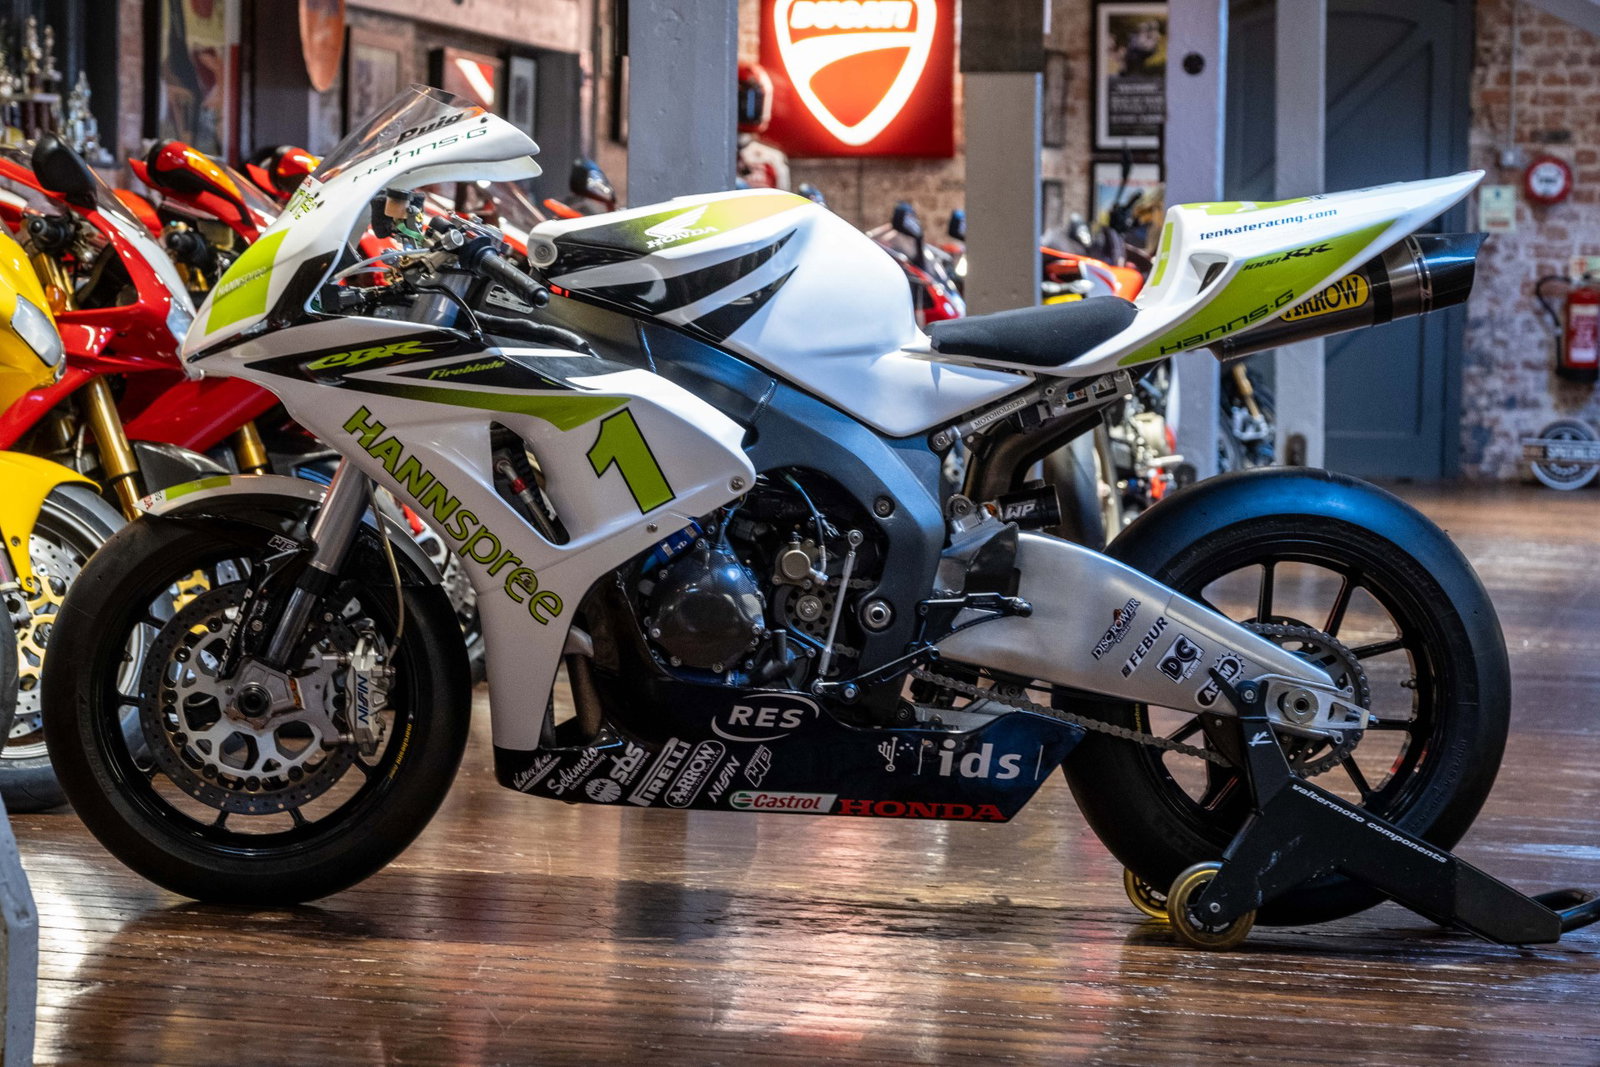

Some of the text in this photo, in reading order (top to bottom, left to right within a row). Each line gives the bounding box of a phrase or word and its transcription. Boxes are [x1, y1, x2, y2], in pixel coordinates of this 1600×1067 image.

[790, 0, 912, 29] DUCATI
[396, 112, 463, 145] Puig
[646, 226, 720, 249] HONDA
[1200, 208, 1337, 240] tenkateracing.com
[306, 341, 434, 371] CBR
[427, 360, 505, 380] Fireblade
[973, 397, 1026, 429] MOTOHOLDERS
[586, 406, 676, 515] 1
[342, 405, 564, 625] HANNspree
[1005, 503, 1036, 519] WP
[1129, 616, 1168, 667] FEBUR
[1161, 637, 1199, 680] DC
[1205, 664, 1236, 702] AFM
[728, 705, 804, 728] RES
[546, 746, 598, 796] Sebimoto
[609, 740, 644, 784] sbs
[627, 737, 692, 807] PIRELLI
[669, 742, 715, 802] ARROW
[745, 746, 771, 787] WP
[938, 738, 1022, 780] ids
[593, 781, 608, 797] NGK
[753, 793, 822, 810] Castrol
[836, 799, 1008, 821] HONDA
[1292, 782, 1366, 824] valtermoto
[1366, 821, 1448, 864] components
